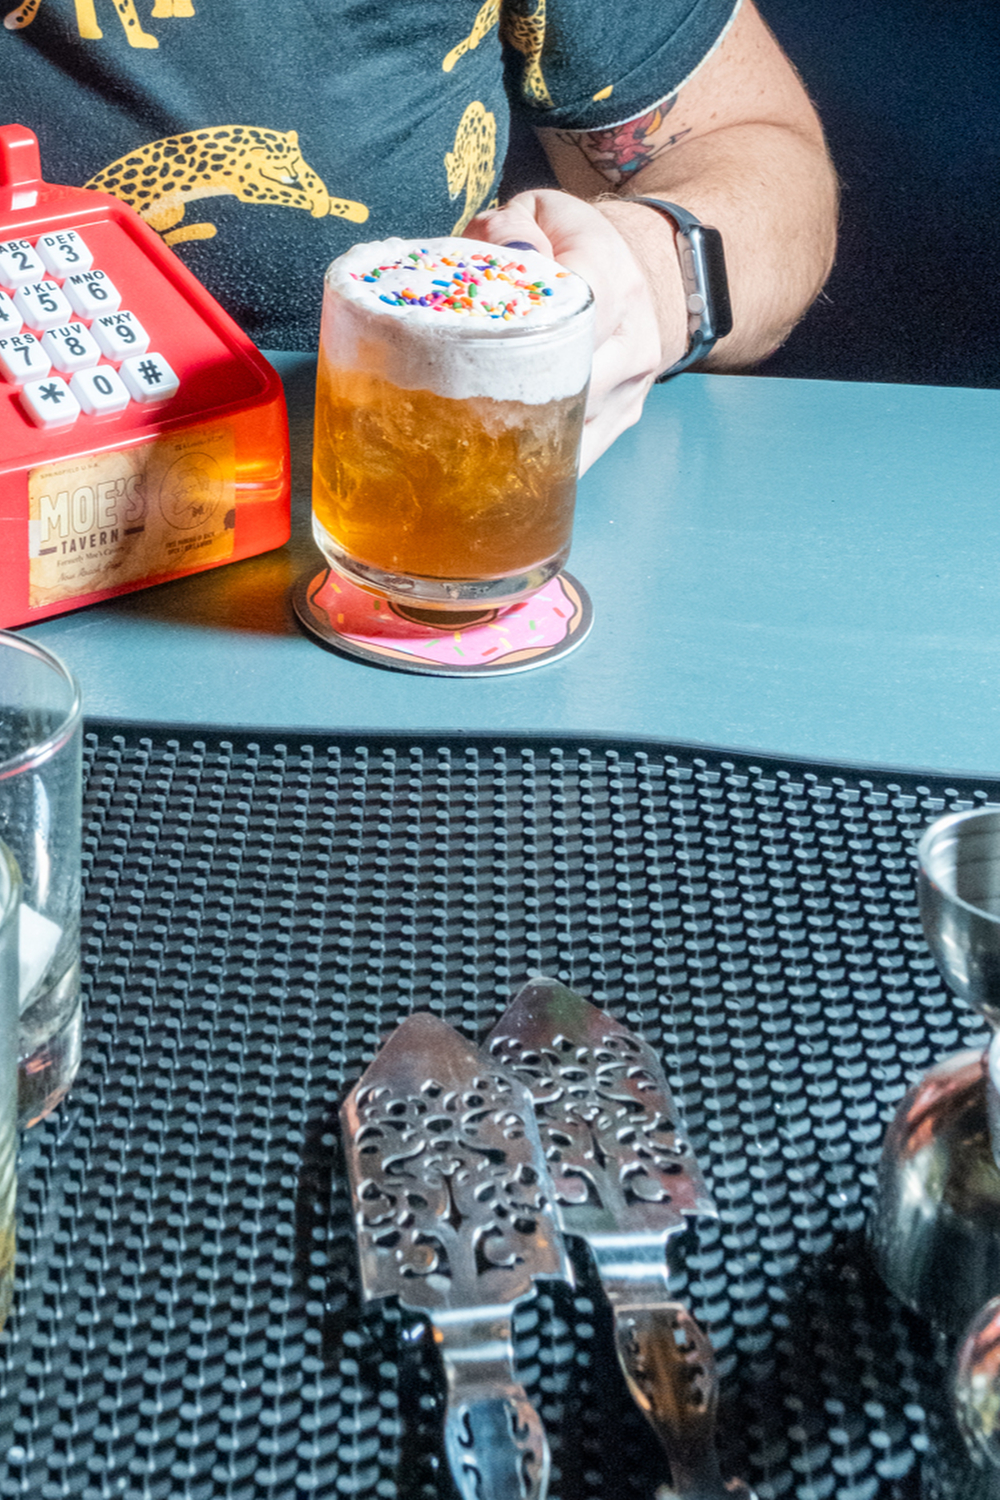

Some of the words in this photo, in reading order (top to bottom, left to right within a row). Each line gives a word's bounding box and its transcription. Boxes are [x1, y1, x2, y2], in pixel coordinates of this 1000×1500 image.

[44, 232, 77, 247] DEF
[11, 251, 35, 271] 2
[59, 244, 80, 263] 3
[69, 270, 105, 286] MNO
[23, 282, 57, 296] JKL
[87, 282, 108, 301] 6
[37, 292, 58, 312] 5
[98, 312, 132, 327] WXY
[46, 324, 82, 339] TUV
[115, 324, 137, 344] 9
[13, 345, 33, 366] 7
[64, 337, 87, 356] 8
[92, 374, 114, 396] 0
[39, 473, 147, 543] MOE'S
[61, 528, 119, 554] TAVERN
